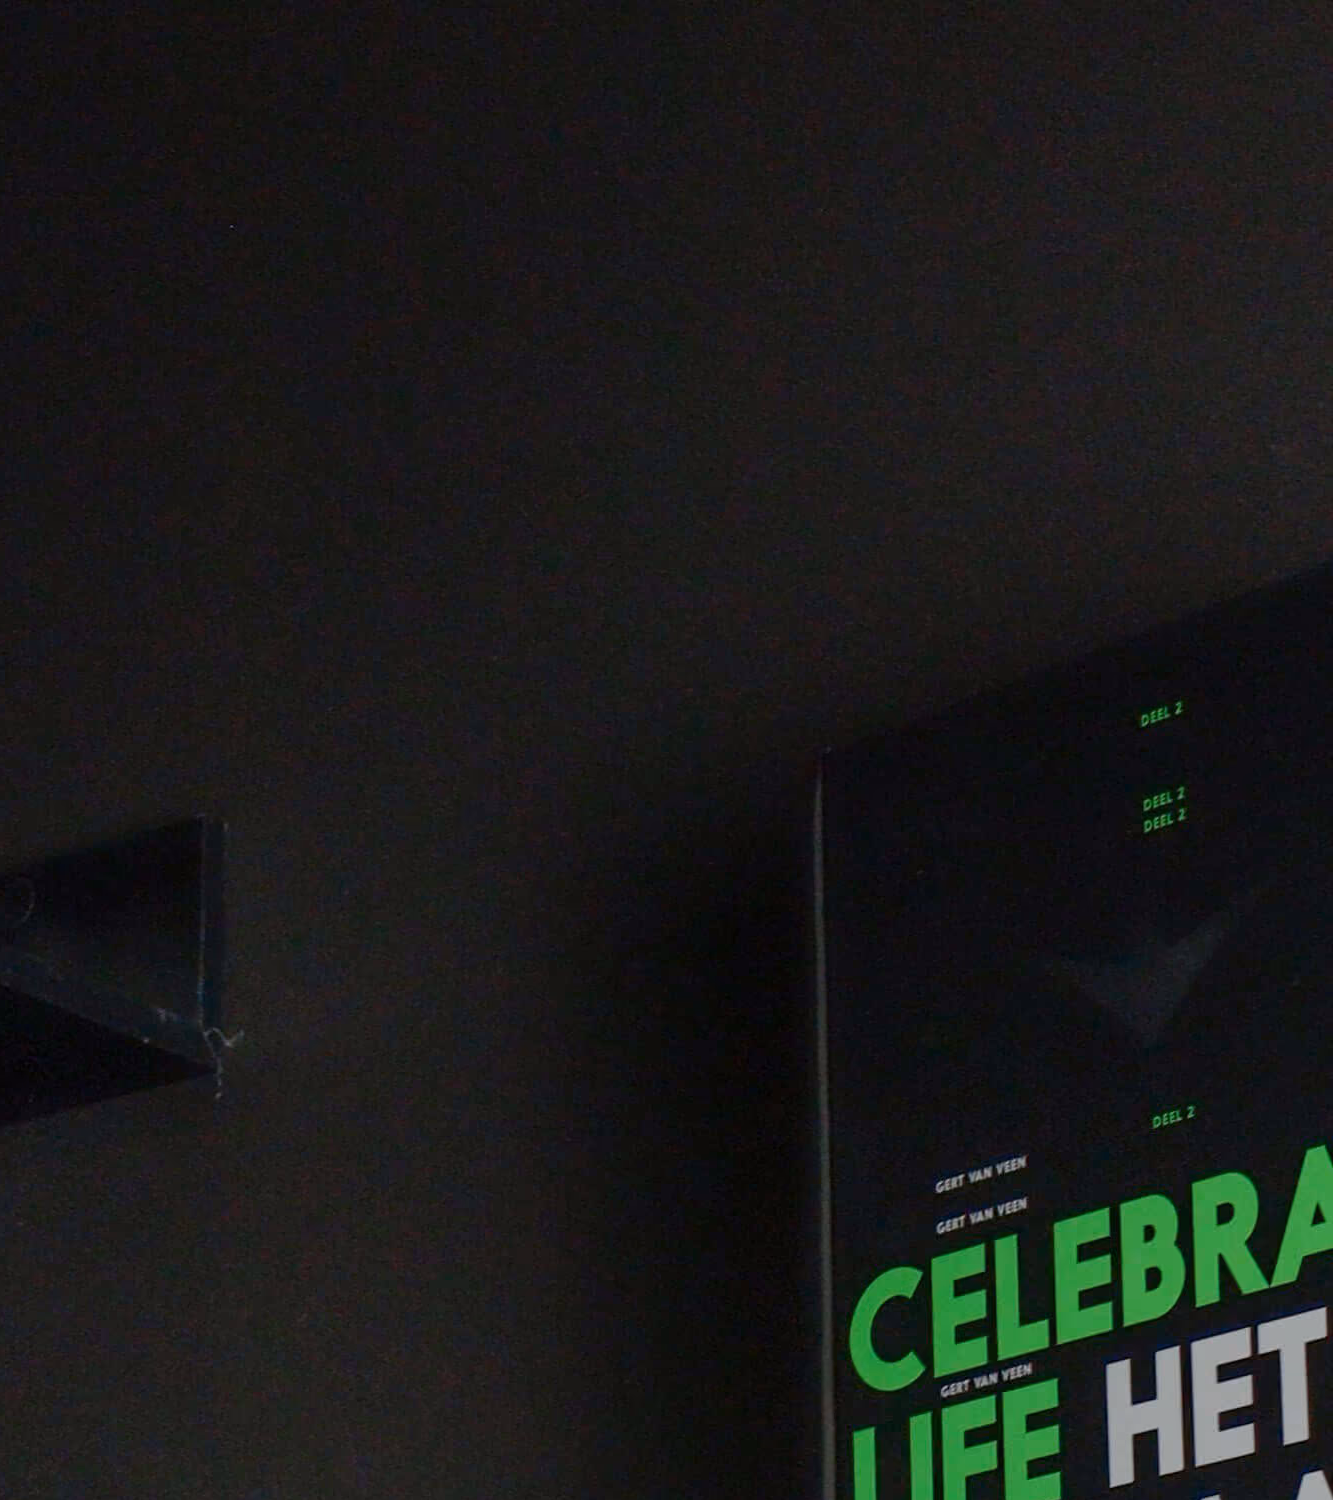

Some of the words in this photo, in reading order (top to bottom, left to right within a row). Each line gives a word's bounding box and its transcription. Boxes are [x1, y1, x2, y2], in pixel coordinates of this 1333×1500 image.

[1140, 706, 1170, 728] DEEL
[1174, 701, 1185, 715] 2
[1143, 791, 1173, 812] DEEL
[1177, 786, 1187, 800] 2
[1143, 813, 1174, 833] DEEL
[1177, 808, 1187, 822] 2
[1151, 1109, 1182, 1130] DEEL
[1187, 1105, 1196, 1119] 2
[935, 1172, 965, 1194] GERT
[969, 1166, 993, 1185] VAN
[996, 1155, 1028, 1177] VEEN
[936, 1214, 966, 1235] GERT
[970, 1207, 994, 1227] VAN
[997, 1197, 1028, 1218] VEEN
[848, 1144, 1333, 1392] CELEBRA
[940, 1378, 970, 1398] GERT
[974, 1371, 998, 1391] VAN
[1001, 1362, 1033, 1383] VEEN
[1106, 1307, 1328, 1488] HET
